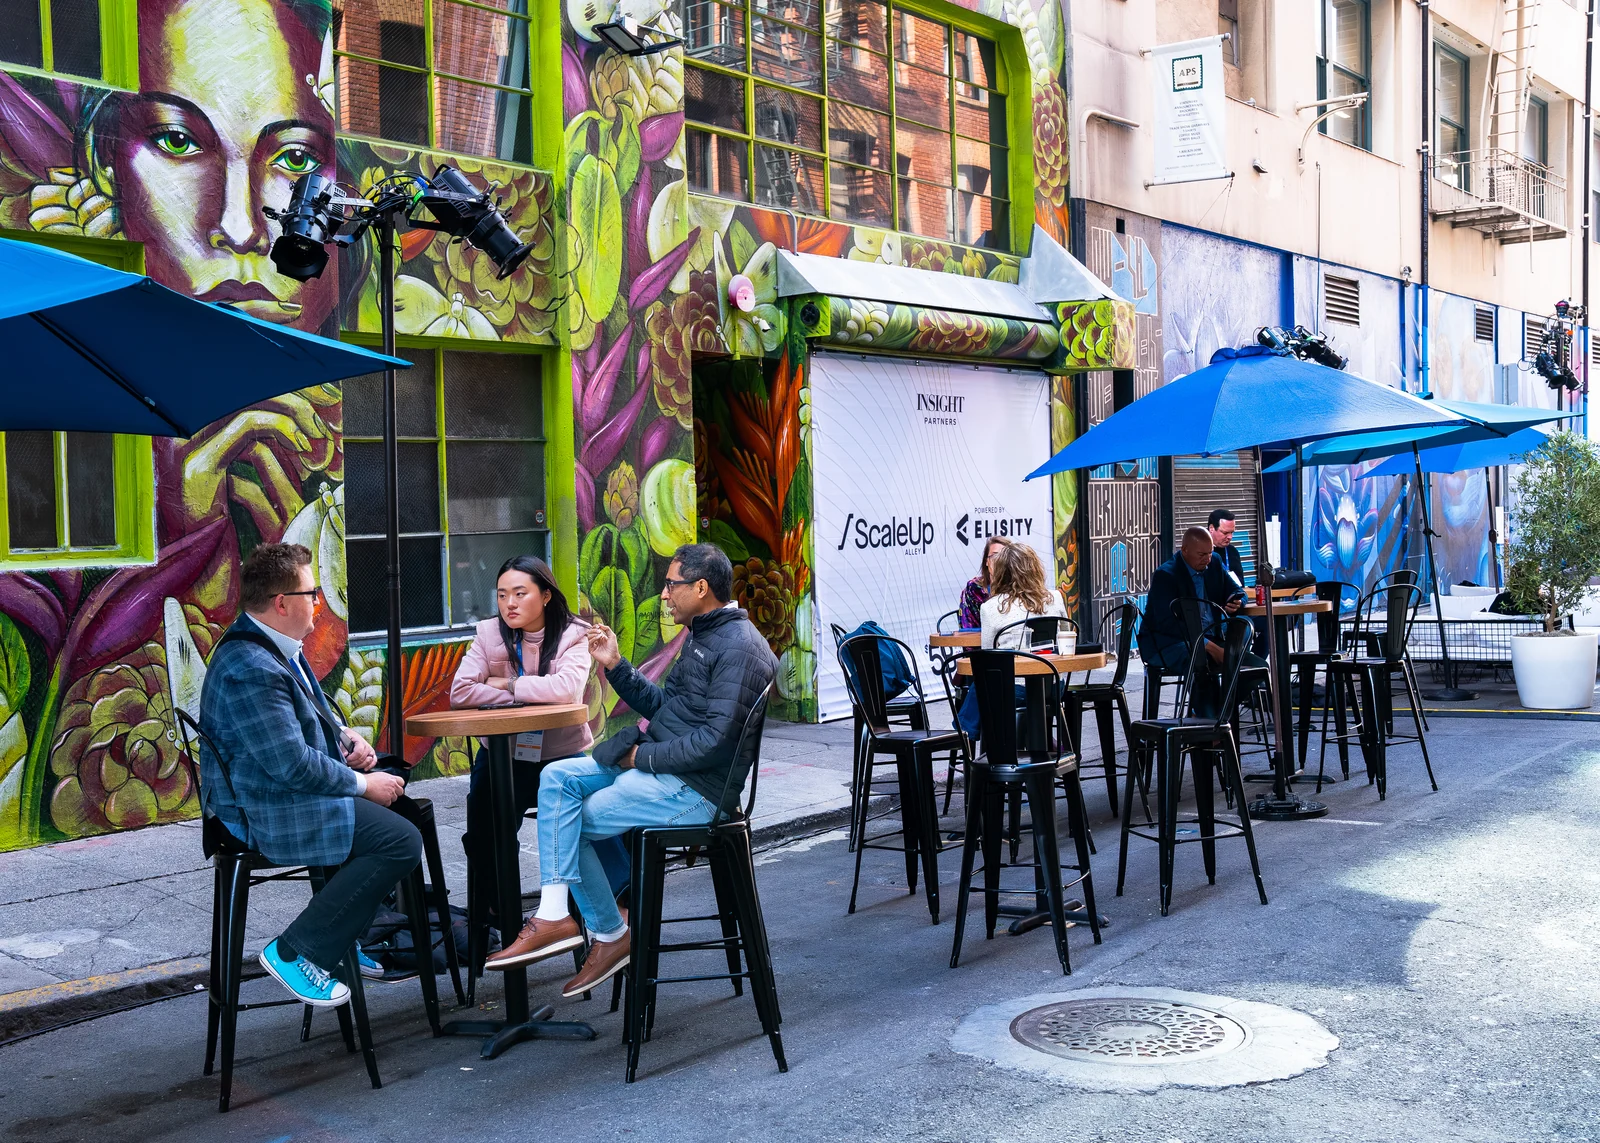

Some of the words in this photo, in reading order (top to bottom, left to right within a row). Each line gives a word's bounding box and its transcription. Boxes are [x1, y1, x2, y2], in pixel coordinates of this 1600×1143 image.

[1179, 67, 1197, 77] APS
[916, 393, 965, 413] INSIGHT
[924, 416, 957, 426] PARTNERS
[974, 506, 998, 514] POWERED
[974, 518, 1033, 539] ELISITY
[904, 547, 922, 556] ALLEY
